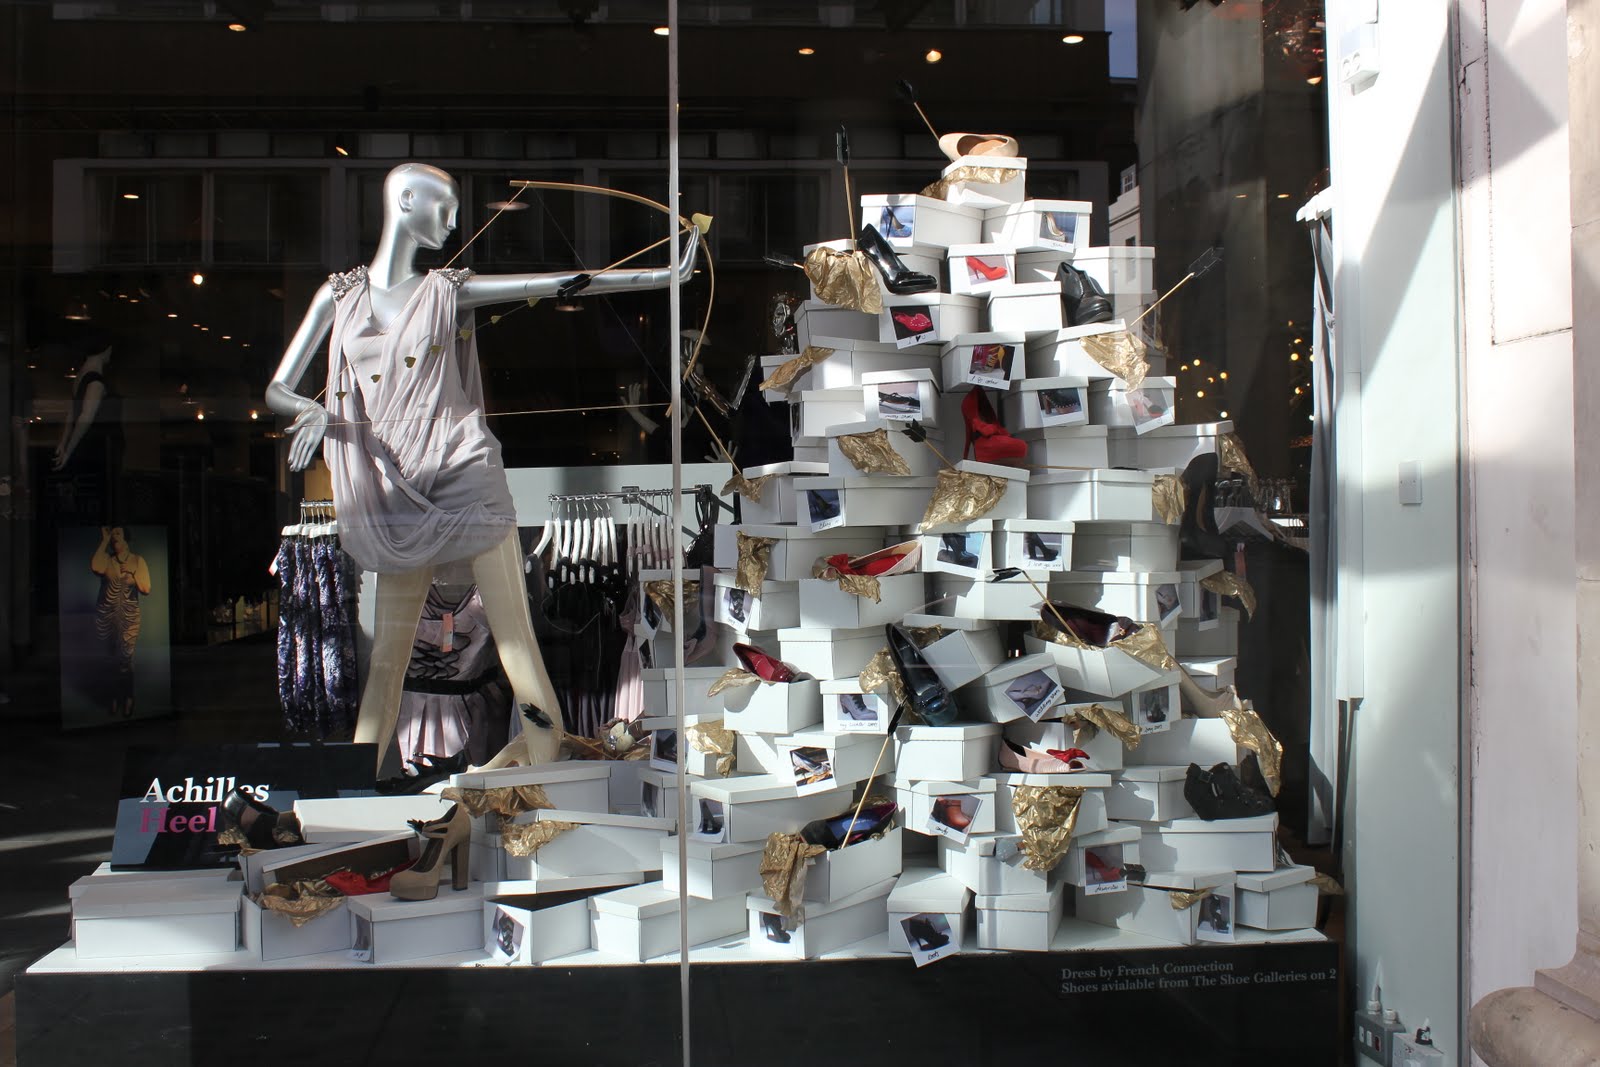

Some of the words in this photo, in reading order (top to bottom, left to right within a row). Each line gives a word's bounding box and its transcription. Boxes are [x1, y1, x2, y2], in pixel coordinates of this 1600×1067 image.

[139, 806, 217, 833] Heel
[1061, 968, 1097, 980] Dress
[1100, 966, 1114, 981] by
[1117, 963, 1160, 977] French
[1163, 960, 1234, 975] Connection
[1061, 982, 1099, 993] Shoes
[1159, 977, 1189, 989] from
[1192, 975, 1217, 987] The
[1220, 973, 1251, 985] Shoe
[1253, 970, 1308, 984] Galleries
[1310, 971, 1326, 980] on
[1329, 967, 1337, 979] 2
